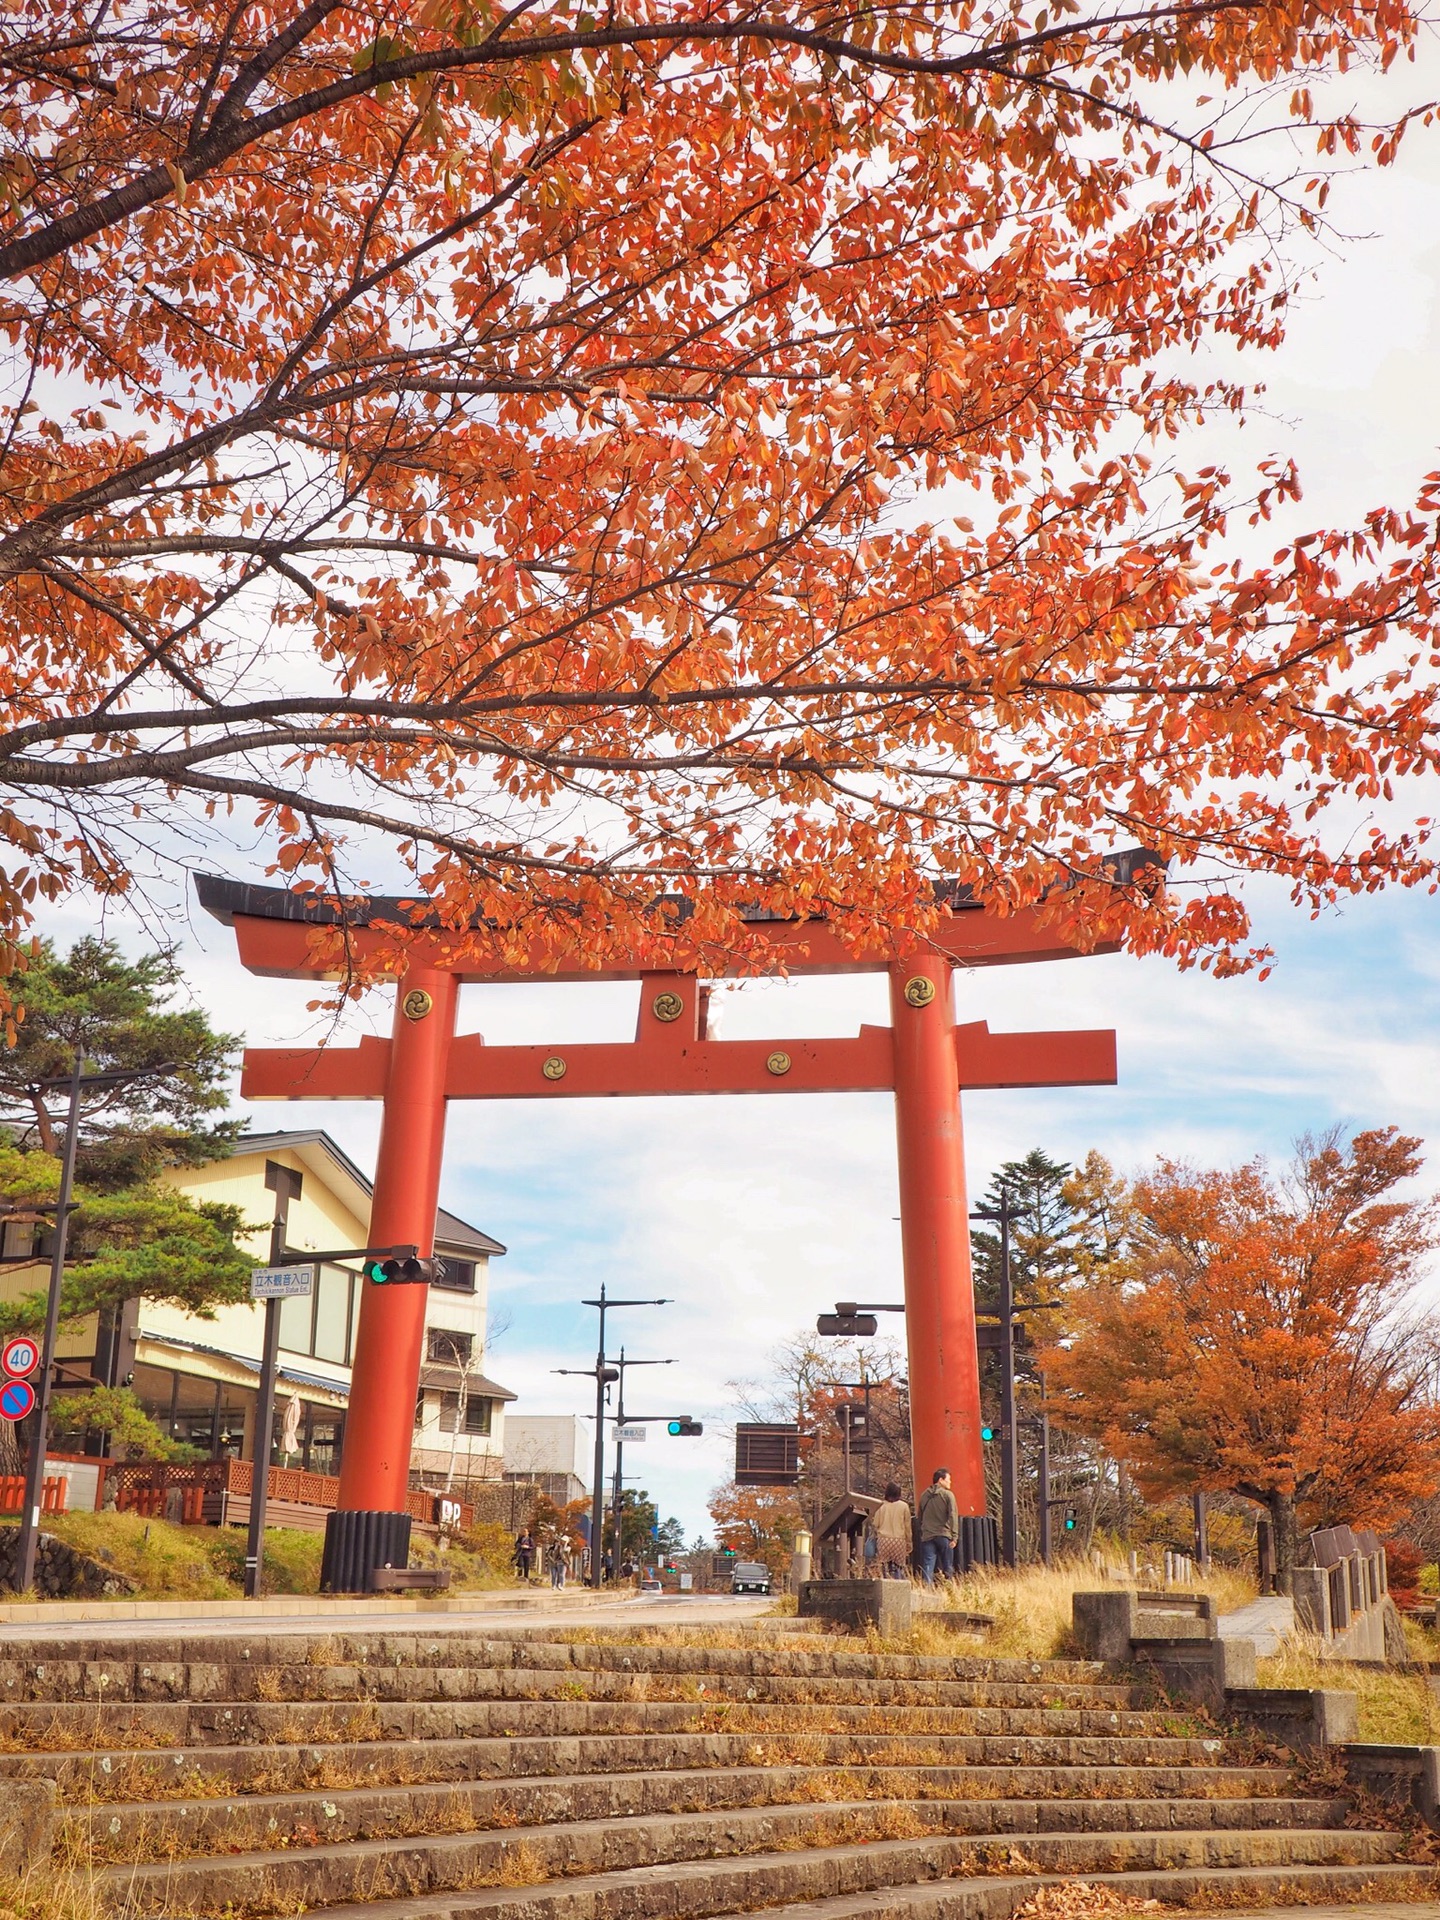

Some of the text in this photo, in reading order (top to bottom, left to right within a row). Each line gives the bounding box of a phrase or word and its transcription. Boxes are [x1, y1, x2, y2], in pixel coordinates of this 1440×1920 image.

[254, 1273, 310, 1287] 立木観音入口
[285, 1286, 299, 1294] Statue
[10, 1349, 31, 1367] 40
